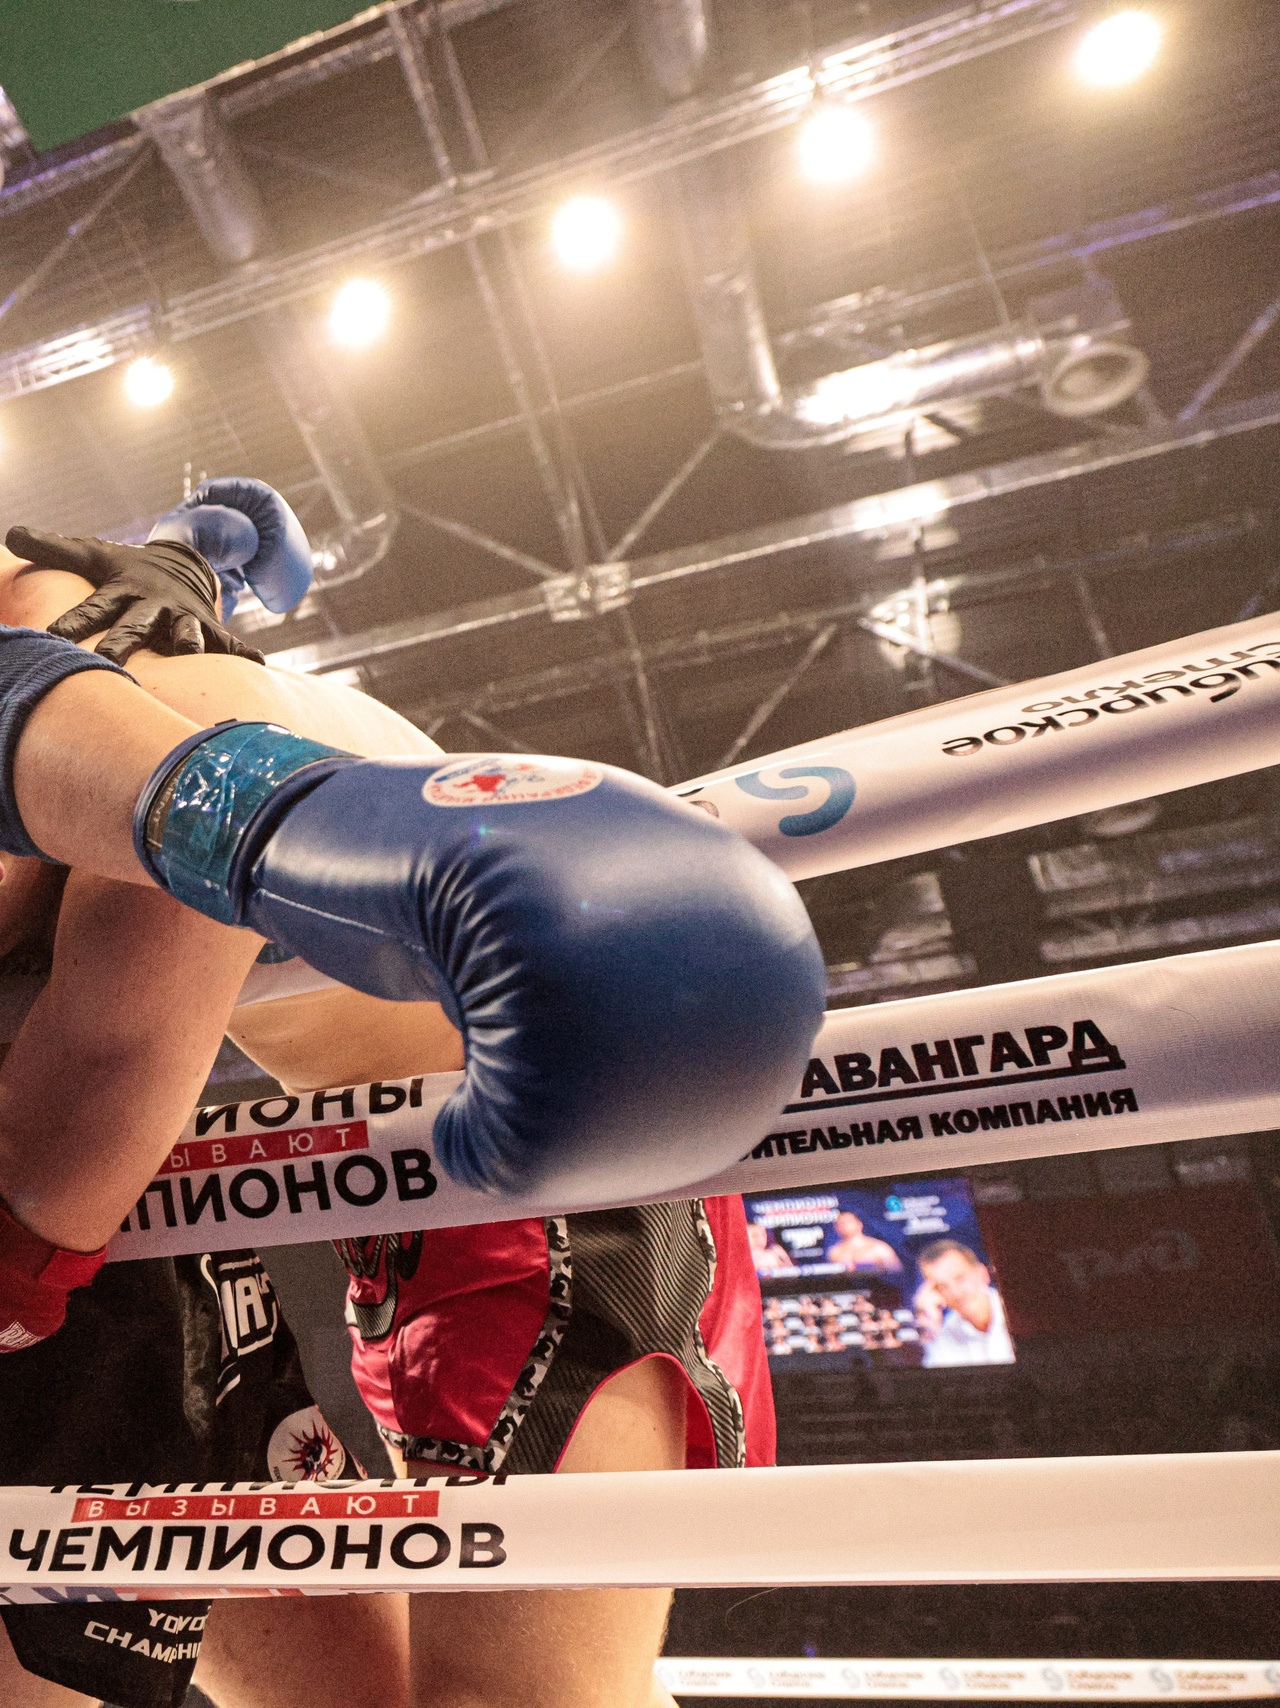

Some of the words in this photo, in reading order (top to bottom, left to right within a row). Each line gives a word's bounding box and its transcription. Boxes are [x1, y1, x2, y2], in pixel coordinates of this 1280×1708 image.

[800, 1019, 1126, 1098] АВАНГАРД
[178, 1078, 424, 1137] ИОНЫ
[739, 1115, 924, 1162] ИТЕЛЬНАЯ
[929, 1087, 1140, 1137] КОМПАНИЯ
[87, 1493, 420, 1519] ВЫЗЫВАЮТ
[7, 1522, 507, 1572] ЧЕМПИОНОВ
